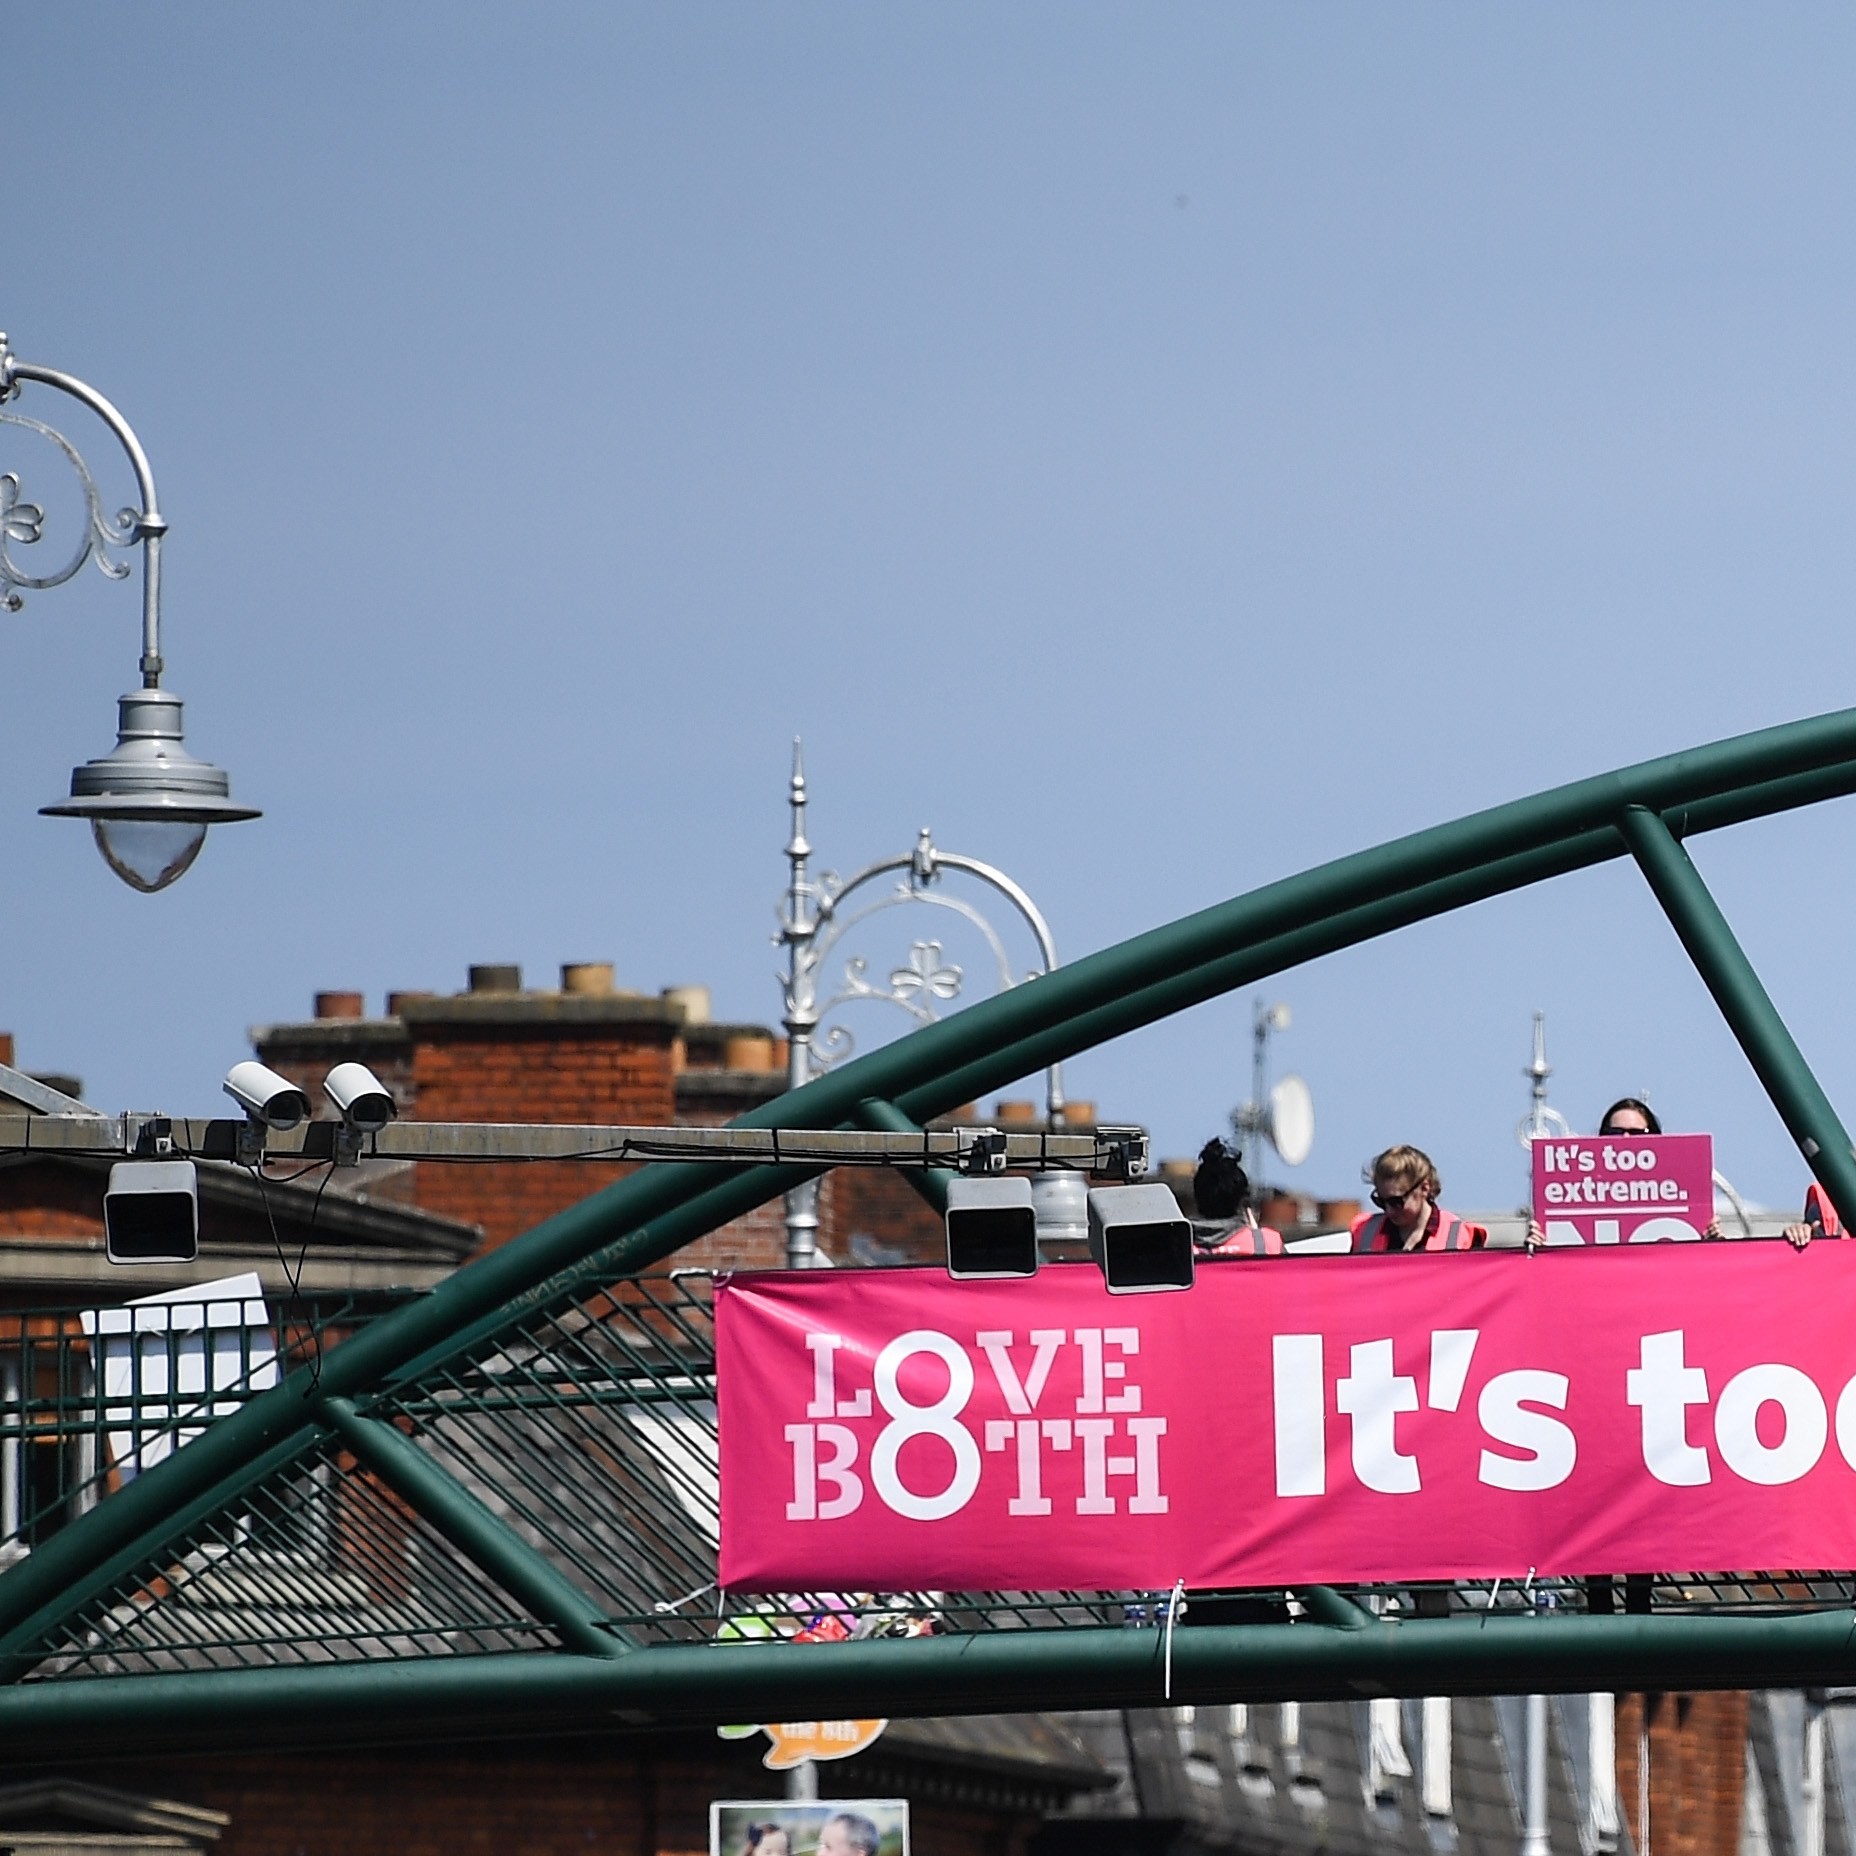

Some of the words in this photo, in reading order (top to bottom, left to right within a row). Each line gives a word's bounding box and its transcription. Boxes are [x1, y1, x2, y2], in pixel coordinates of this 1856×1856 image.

[1544, 1177, 1688, 1202] extreme.
[1545, 1145, 1595, 1172] It's
[1602, 1145, 1656, 1172] too
[804, 1327, 1142, 1419] LOVE
[1272, 1328, 1578, 1498] It's
[784, 1412, 1170, 1522] BOTH
